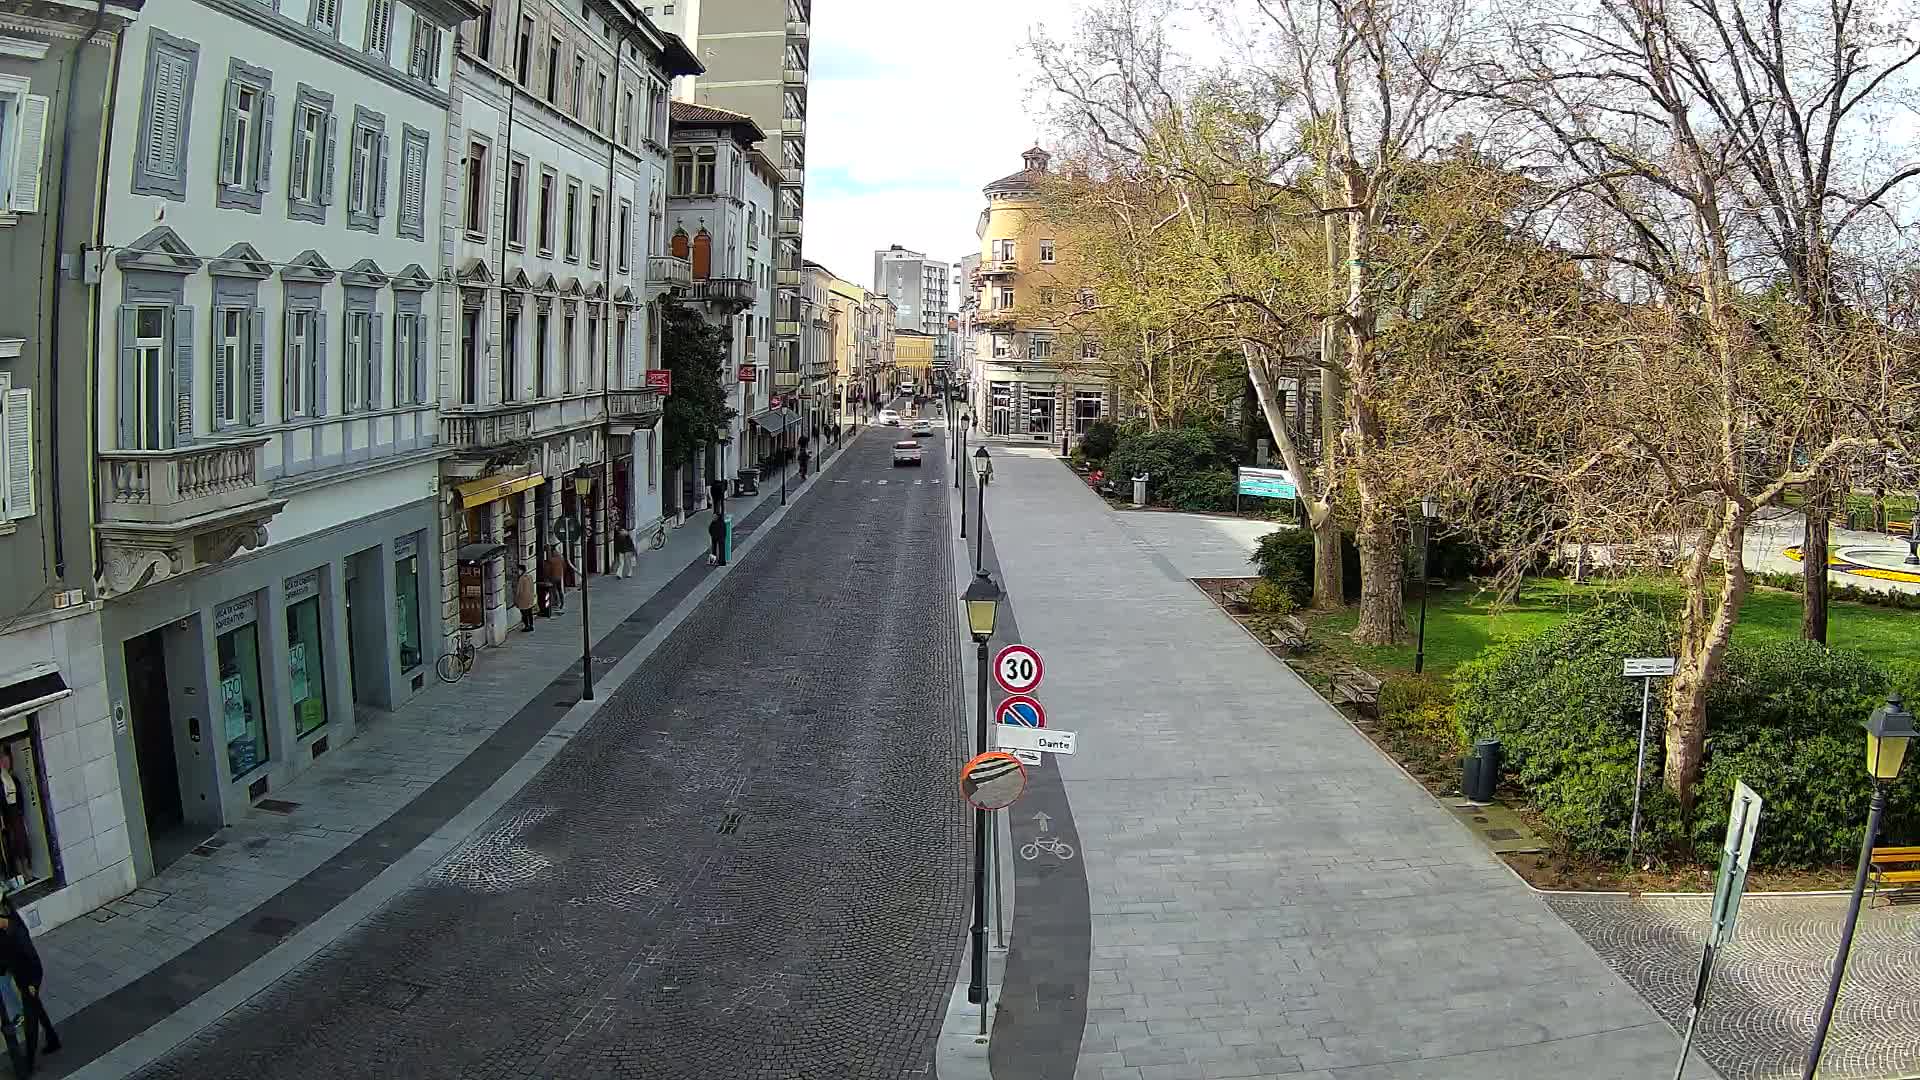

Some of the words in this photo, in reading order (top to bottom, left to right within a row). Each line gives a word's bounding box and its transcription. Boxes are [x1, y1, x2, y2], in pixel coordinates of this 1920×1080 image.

[1006, 659, 1033, 680] 30
[223, 679, 241, 701] 130
[1038, 738, 1070, 749] Dante
